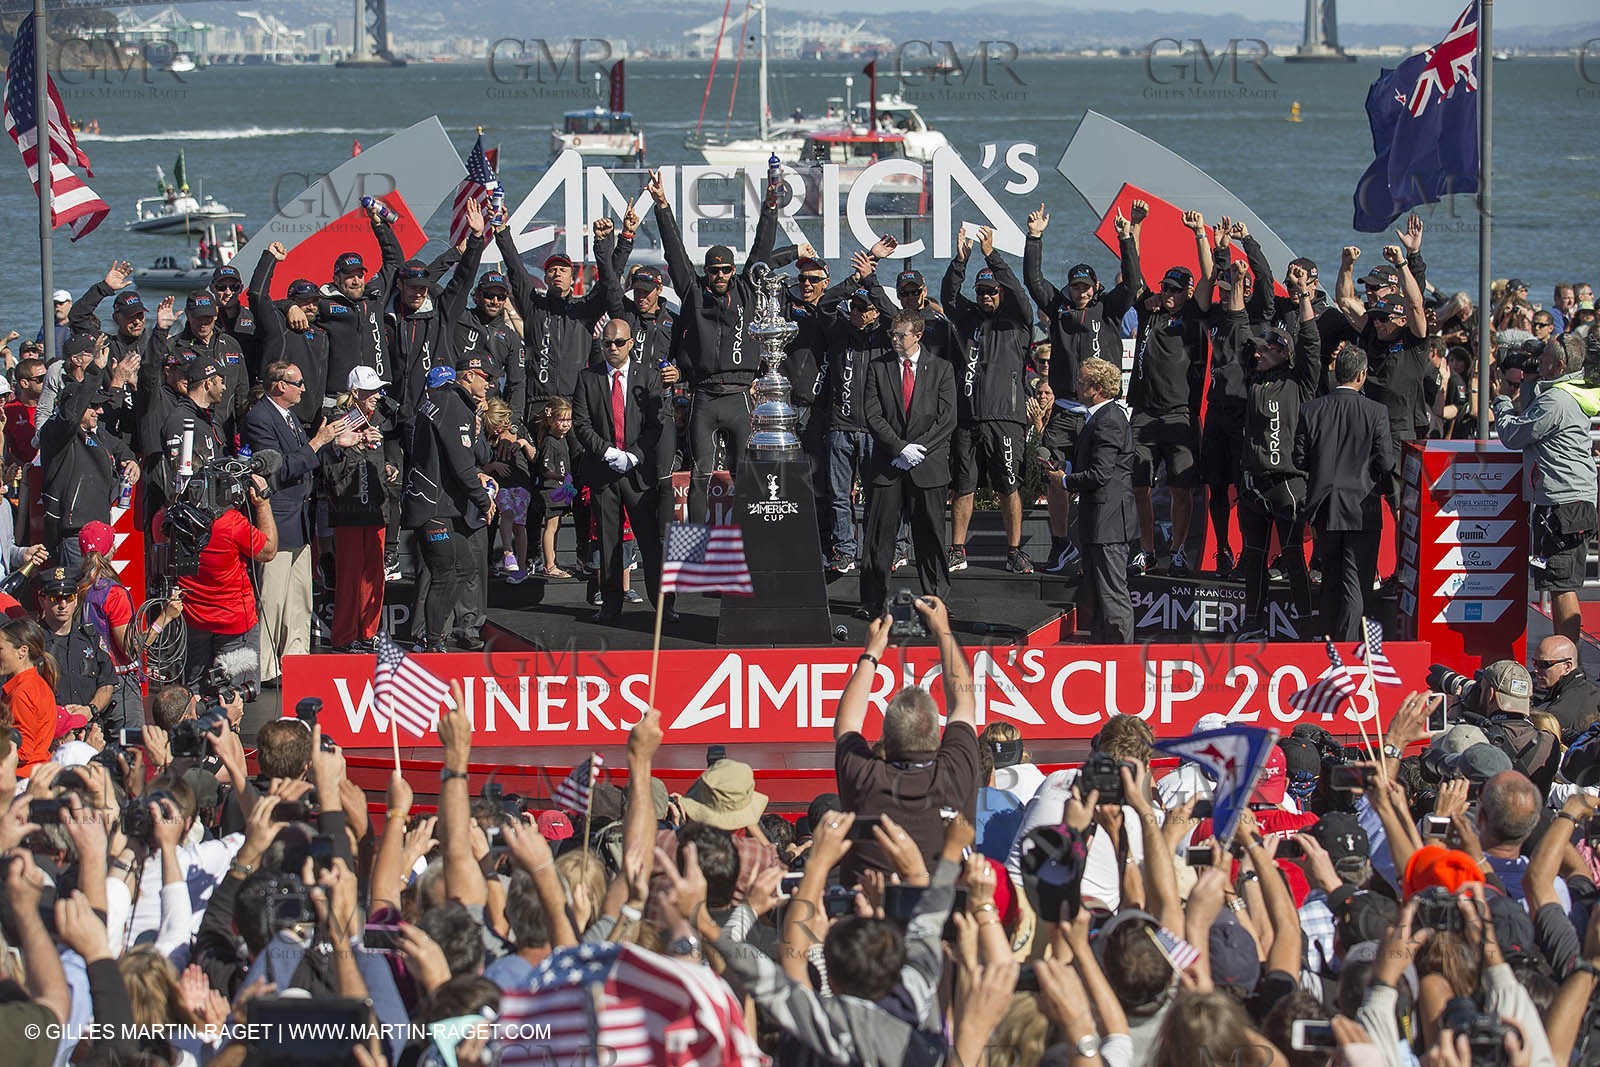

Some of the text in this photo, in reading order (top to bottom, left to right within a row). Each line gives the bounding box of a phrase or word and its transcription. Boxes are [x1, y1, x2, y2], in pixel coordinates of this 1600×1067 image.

[368, 311, 384, 377] ORACLE
[732, 304, 745, 365] ORACLE
[964, 327, 982, 397] ORACLE
[1268, 400, 1280, 466] ORACLE
[1452, 472, 1503, 481] ORACLE
[430, 532, 450, 541] USA
[1459, 531, 1484, 540] PUMA
[1136, 592, 1301, 639] AMERIA'S
[1171, 585, 1247, 600] SAN FRANCISCO
[332, 673, 653, 734] WNNERS
[1050, 659, 1205, 726] CUP
[1224, 664, 1380, 724] 203
